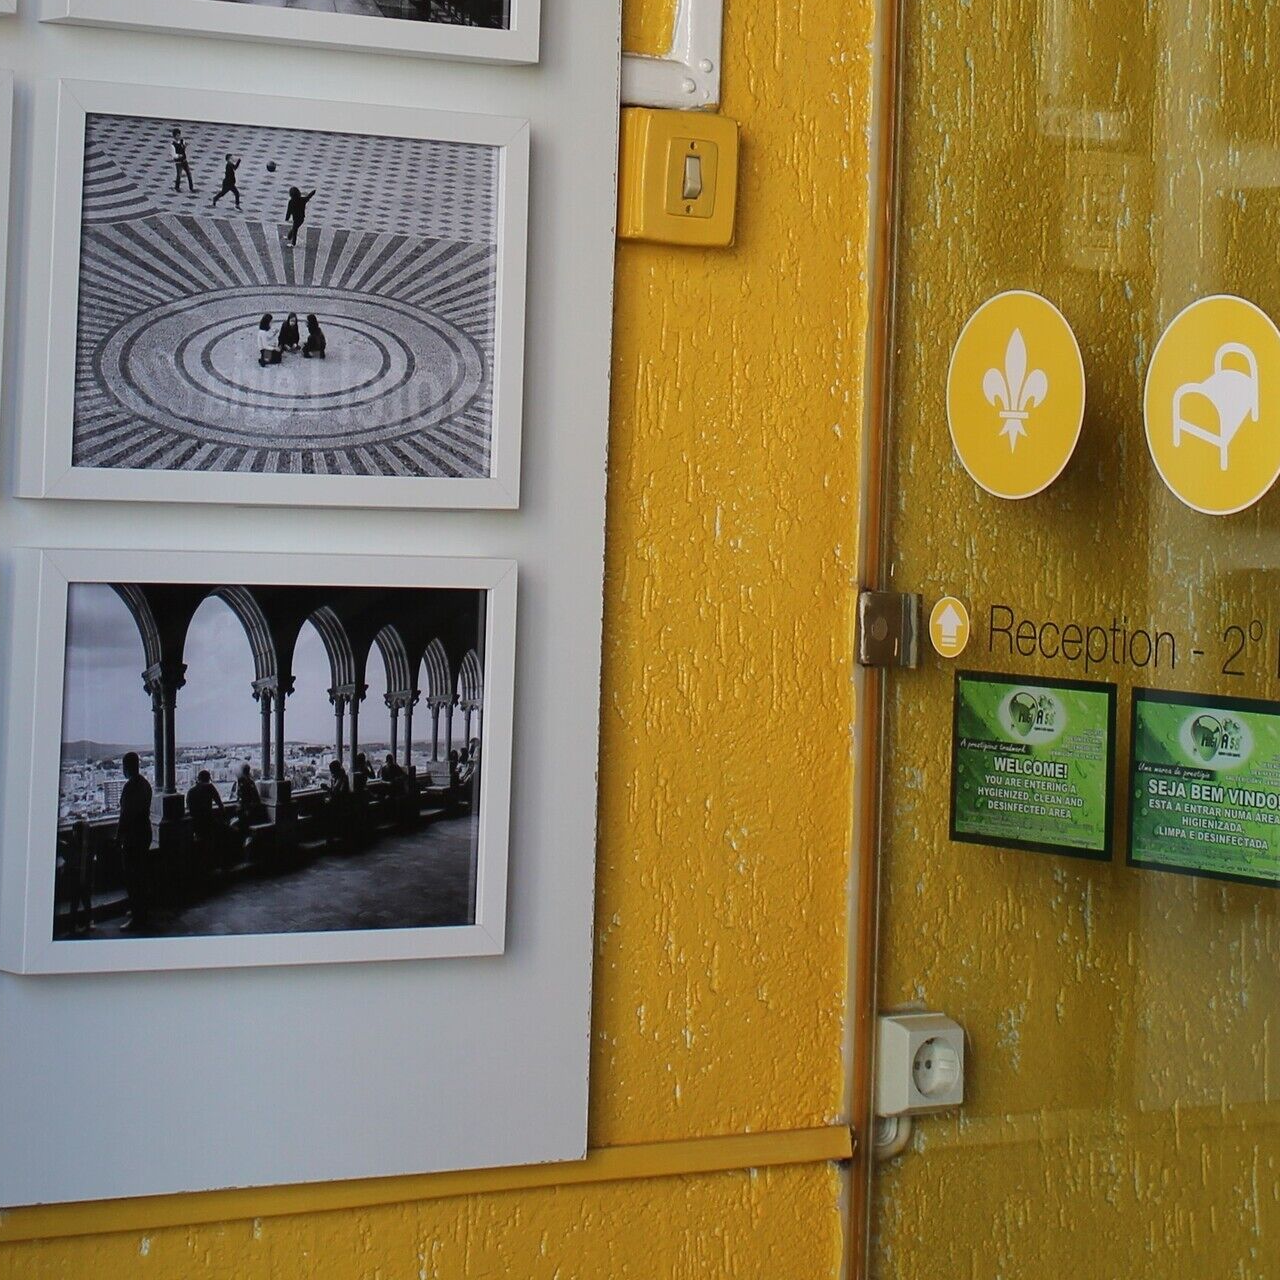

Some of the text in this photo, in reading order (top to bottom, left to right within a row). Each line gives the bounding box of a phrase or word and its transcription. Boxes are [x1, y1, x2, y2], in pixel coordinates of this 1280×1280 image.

[988, 604, 1176, 674] Reception
[994, 757, 1068, 779] WELCOME!
[985, 775, 1076, 794] YOU ARE ENTERING A
[1148, 779, 1186, 798] SEJA
[1191, 783, 1224, 803] BEM
[988, 800, 1072, 819] DESINFECTED AREA
[1033, 793, 1062, 804] CLEAN
[1064, 798, 1083, 807] AND
[1175, 802, 1182, 811] A
[1184, 804, 1223, 817] ENTRAR
[1224, 809, 1253, 821] NUMA
[1159, 826, 1268, 850] LIMPA E DESINFECTADA
